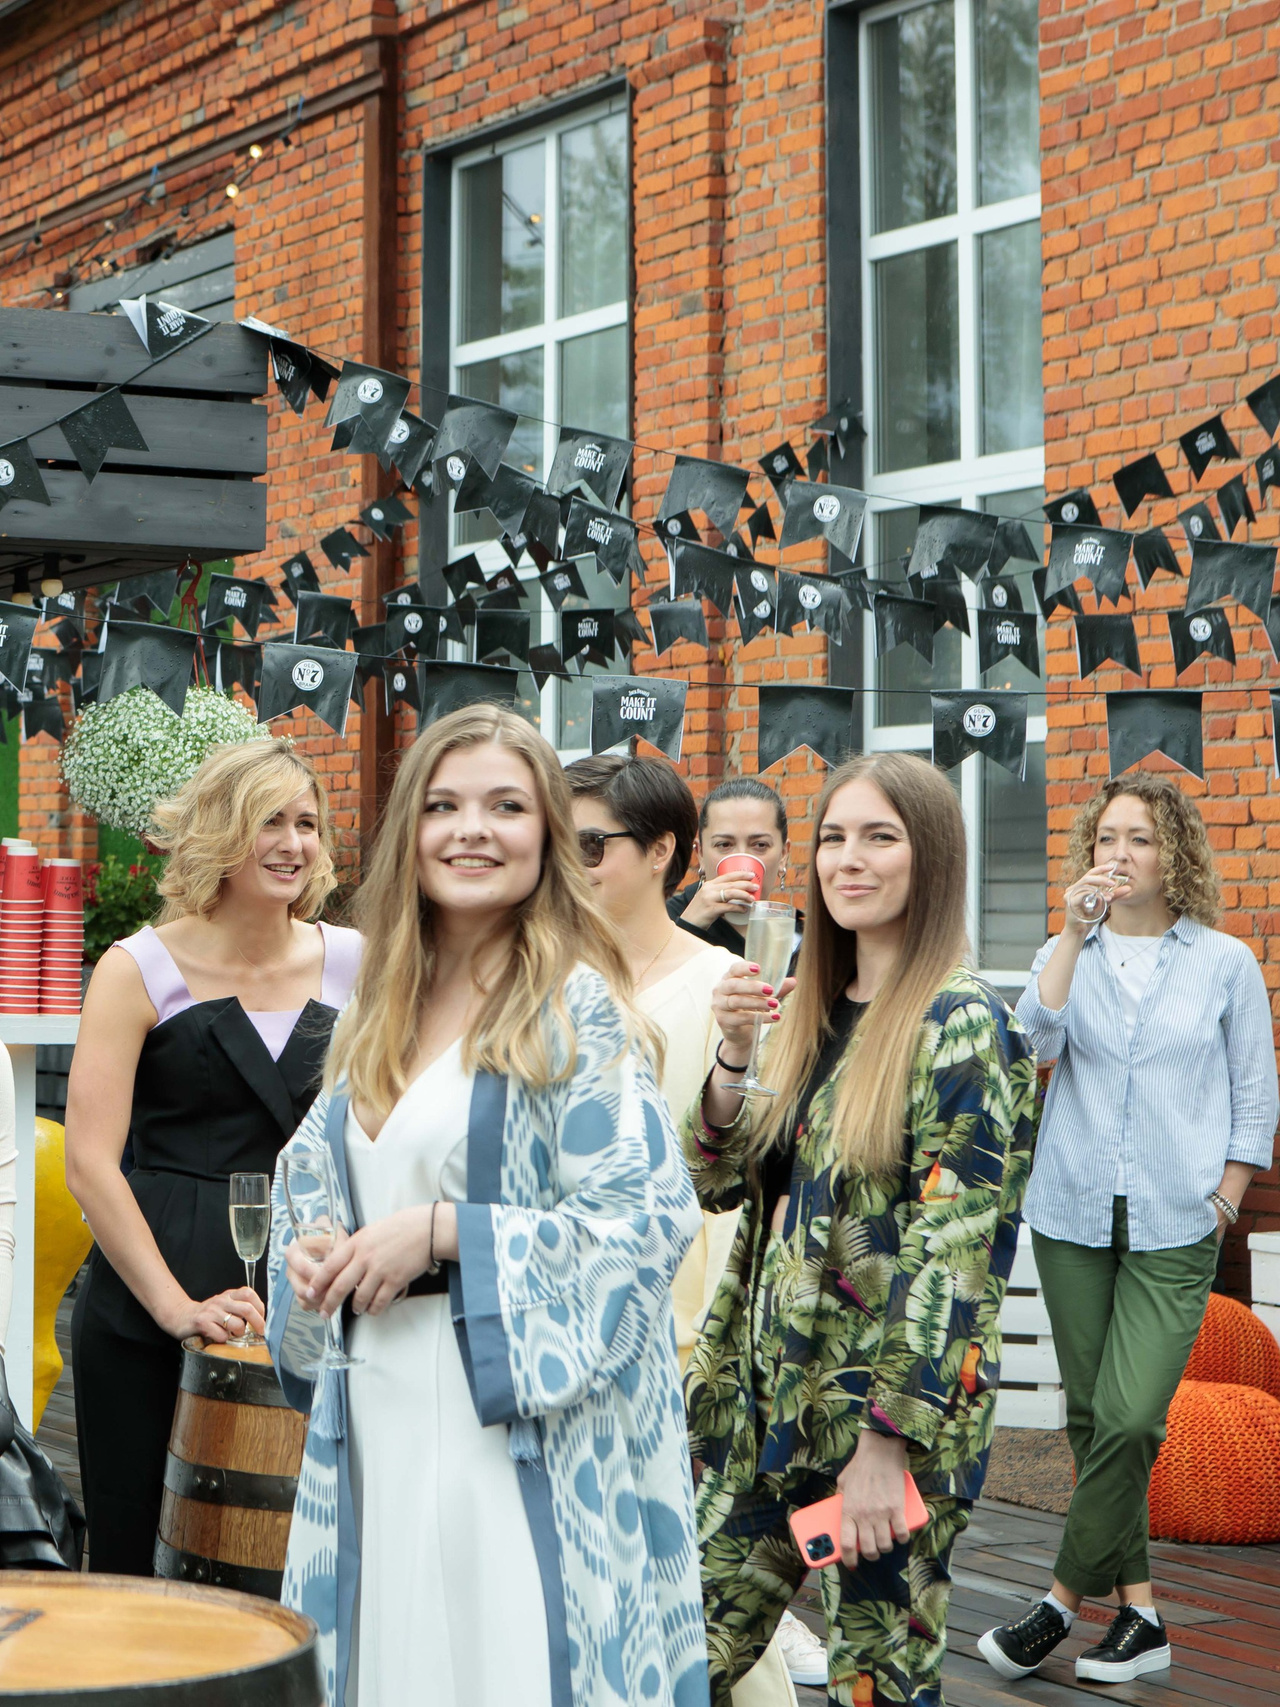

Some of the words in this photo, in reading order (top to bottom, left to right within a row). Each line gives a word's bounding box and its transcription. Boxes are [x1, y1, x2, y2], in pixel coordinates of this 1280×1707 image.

[576, 448, 597, 460] MAKE
[597, 452, 607, 463] IT
[574, 456, 604, 473] COUNT
[588, 519, 605, 533] MAKE
[604, 526, 614, 537] IT
[586, 527, 612, 546] COUNT
[1074, 543, 1095, 554] MAKE
[1095, 545, 1106, 556] IT
[1073, 552, 1104, 566] COUNT
[996, 625, 1012, 635] MAKE
[1012, 627, 1020, 636] IT
[996, 634, 1021, 646] COUNT
[620, 696, 645, 707] MAKE
[646, 697, 657, 708] IT
[620, 706, 656, 721] COUNT
